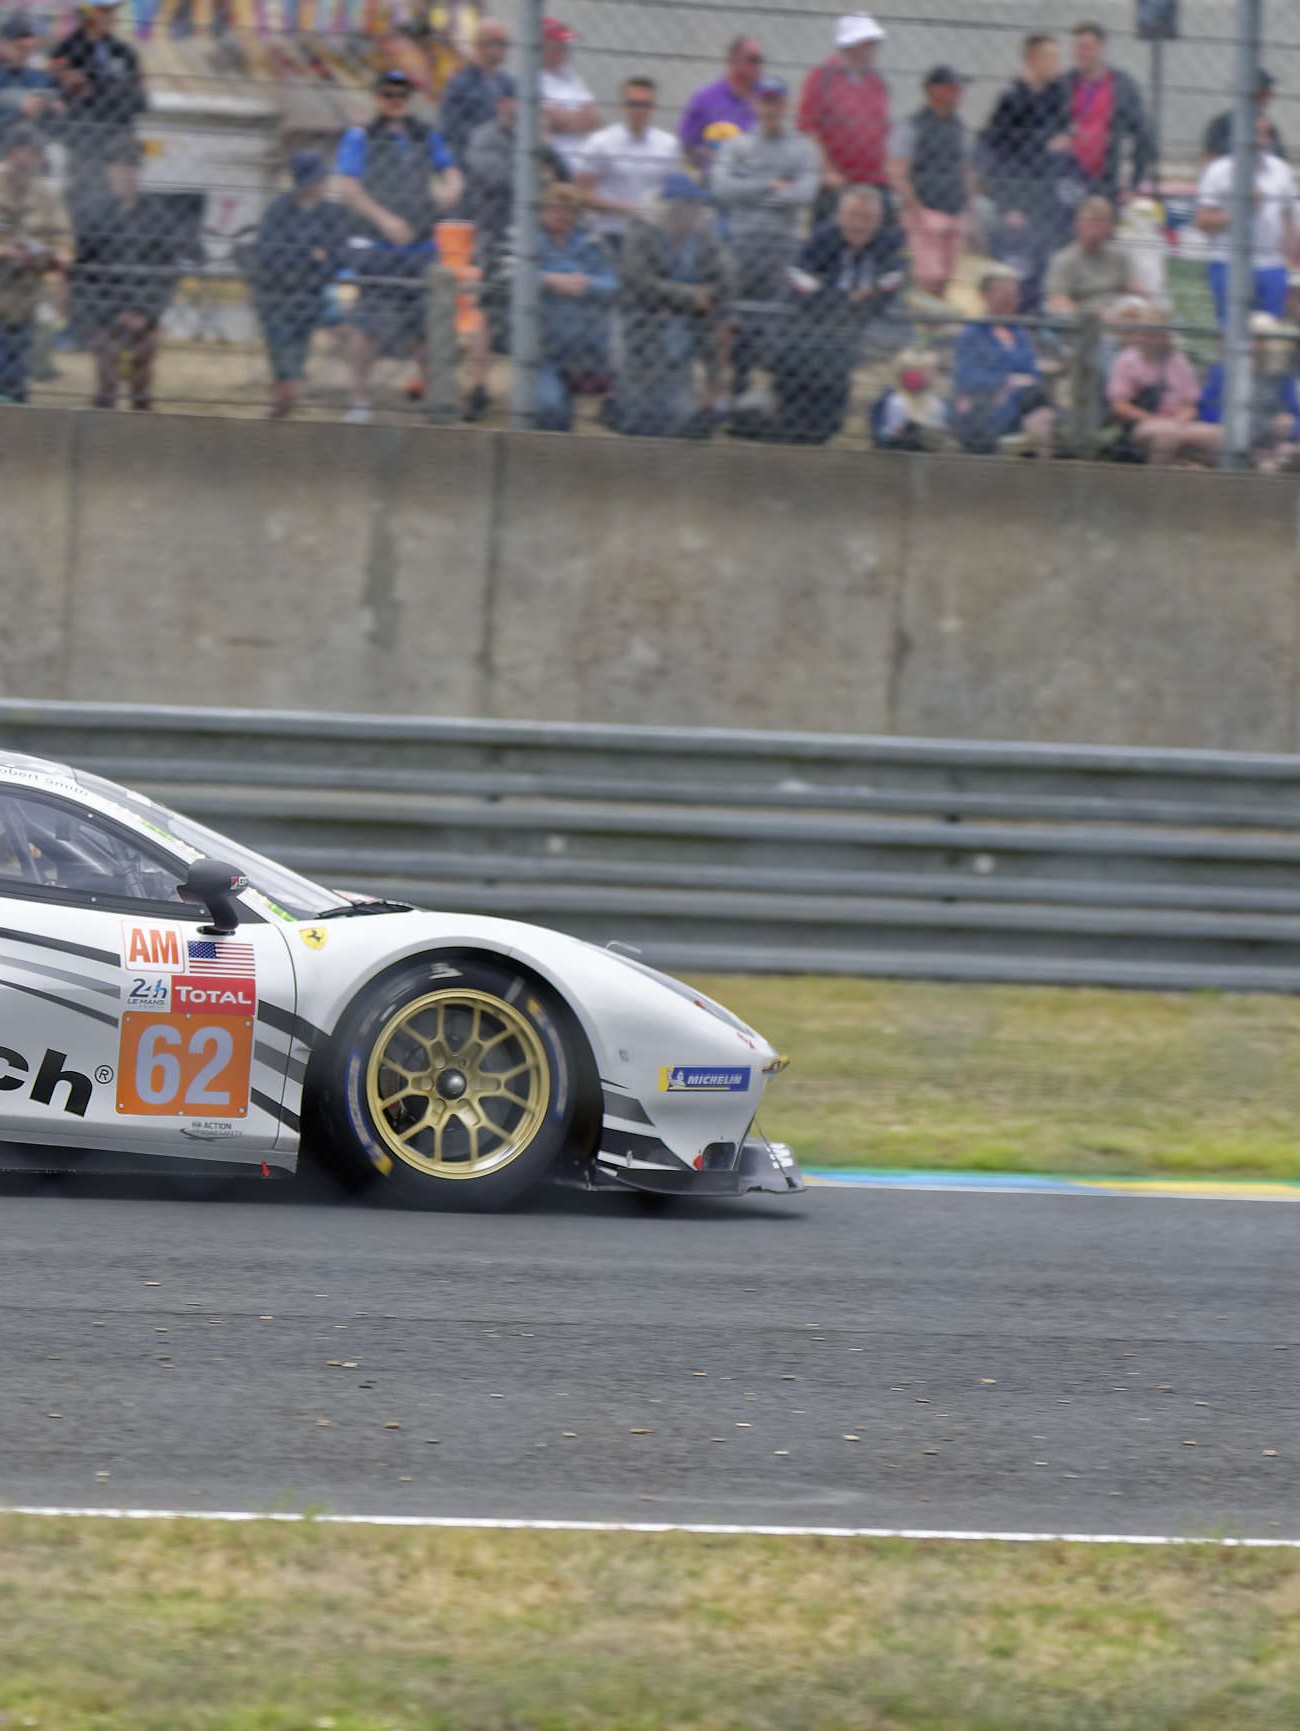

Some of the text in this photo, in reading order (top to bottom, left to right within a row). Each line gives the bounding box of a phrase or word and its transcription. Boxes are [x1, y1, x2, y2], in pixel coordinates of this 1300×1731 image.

[129, 928, 180, 965] AM
[135, 1024, 234, 1105] 62
[687, 1074, 743, 1085] MICHELIN
[203, 1122, 232, 1130] ACTION
